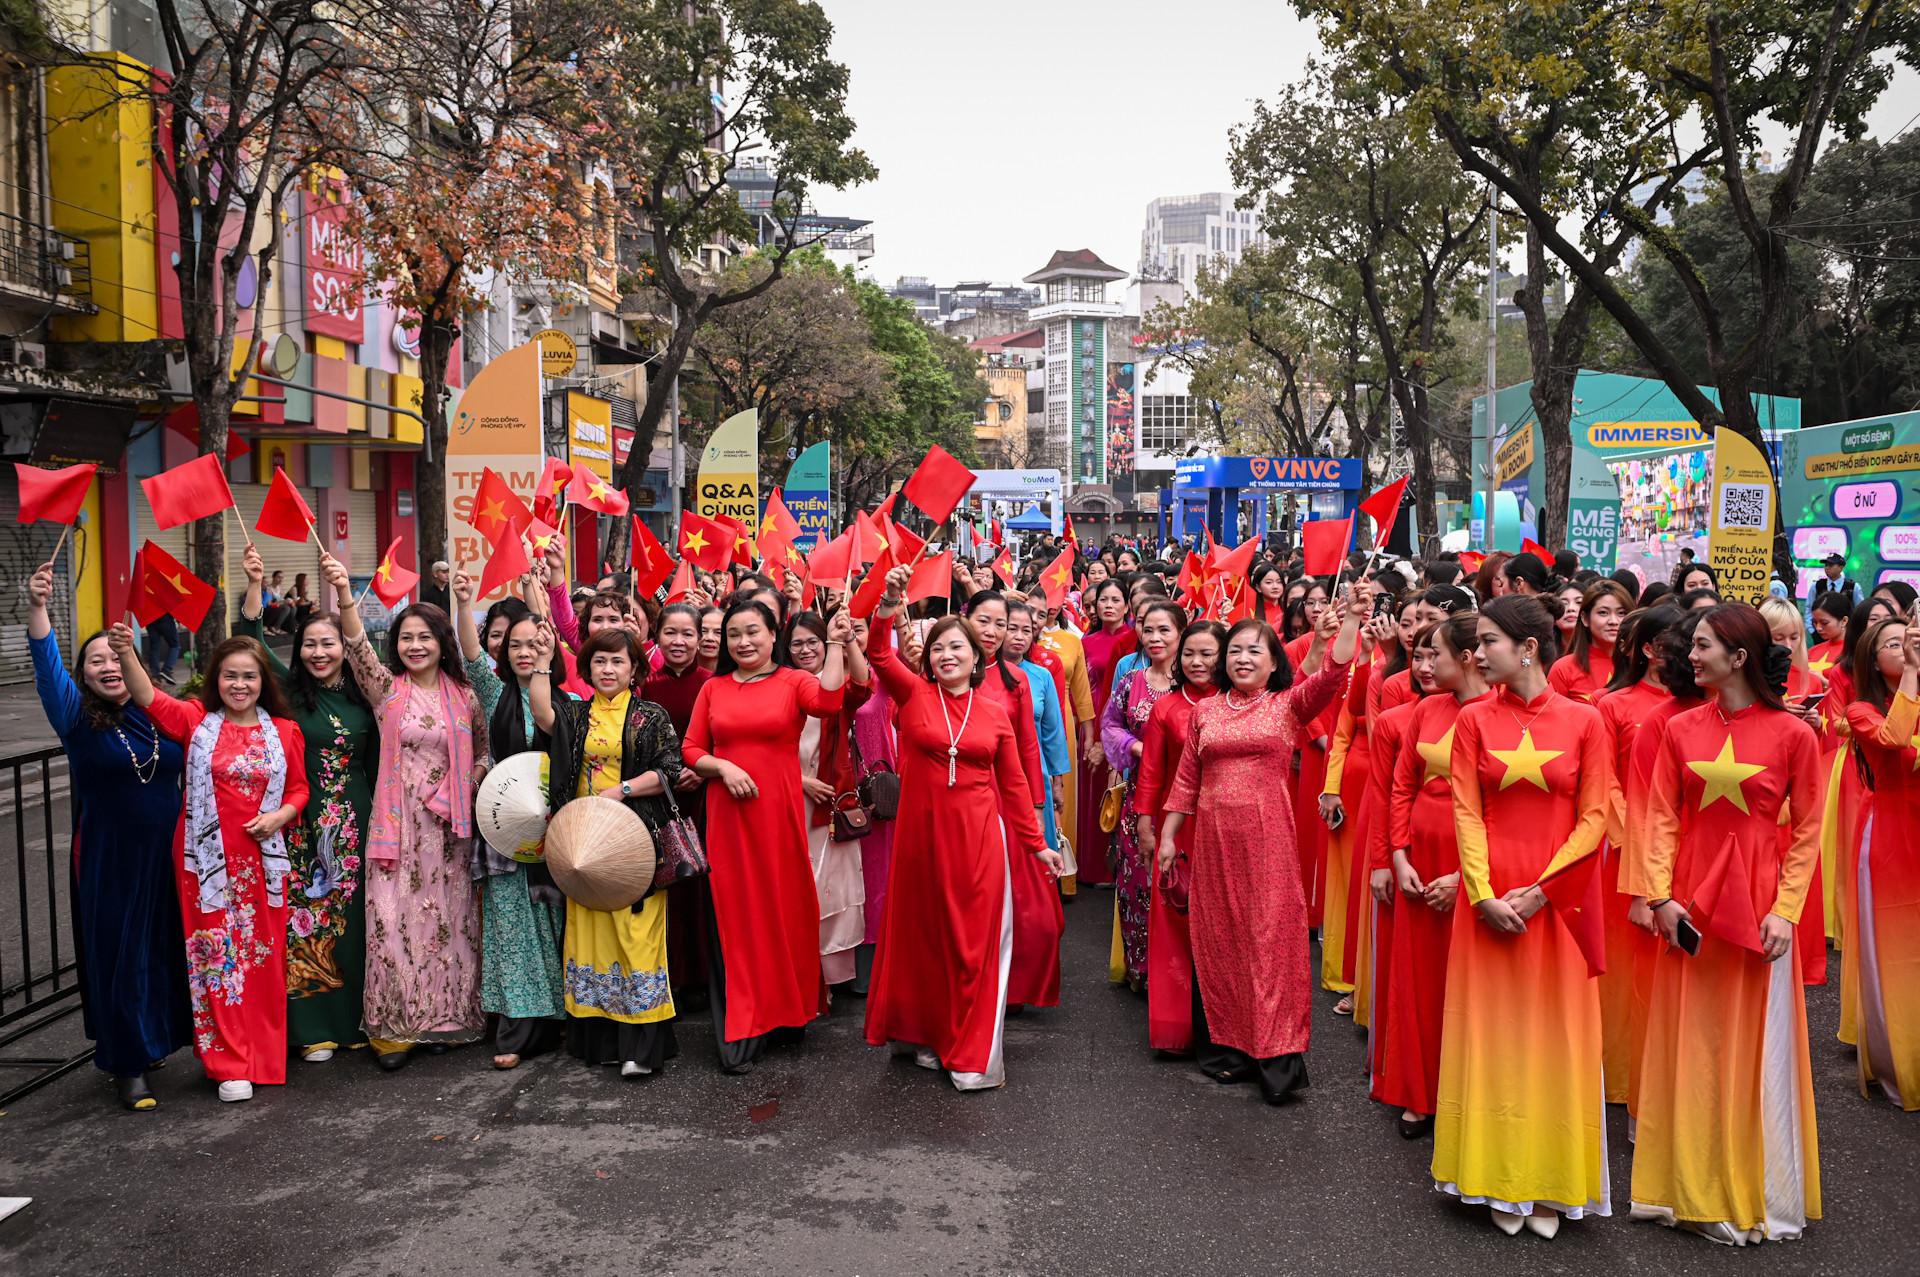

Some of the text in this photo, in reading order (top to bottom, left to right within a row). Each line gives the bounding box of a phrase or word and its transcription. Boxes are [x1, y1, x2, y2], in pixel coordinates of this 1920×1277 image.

[1594, 427, 1714, 442] IMMERSIV
[1508, 450, 1527, 475] ROOM
[1870, 457, 1881, 466] DO
[1881, 455, 1897, 465] HPV
[1272, 459, 1341, 480] VNVC
[1022, 475, 1055, 483] YouMed
[1249, 480, 1257, 488] HỆ
[1295, 480, 1307, 488] TÂM
[1308, 480, 1321, 488] TIÊM
[701, 483, 755, 499] Q&A
[701, 501, 756, 516] CÙNG
[785, 496, 828, 511] TRIỂN
[797, 512, 828, 528] ÃM
[1572, 506, 1616, 528] MÊ
[1571, 527, 1614, 538] CUNG
[1894, 533, 1918, 544] 100%
[1571, 538, 1614, 563] SỰ
[1714, 544, 1768, 555] TRIỂN LÃM
[1714, 554, 1767, 566] MỞ CỬA
[1713, 567, 1766, 582] TỰ DO
[1718, 583, 1745, 591] HÔNG
